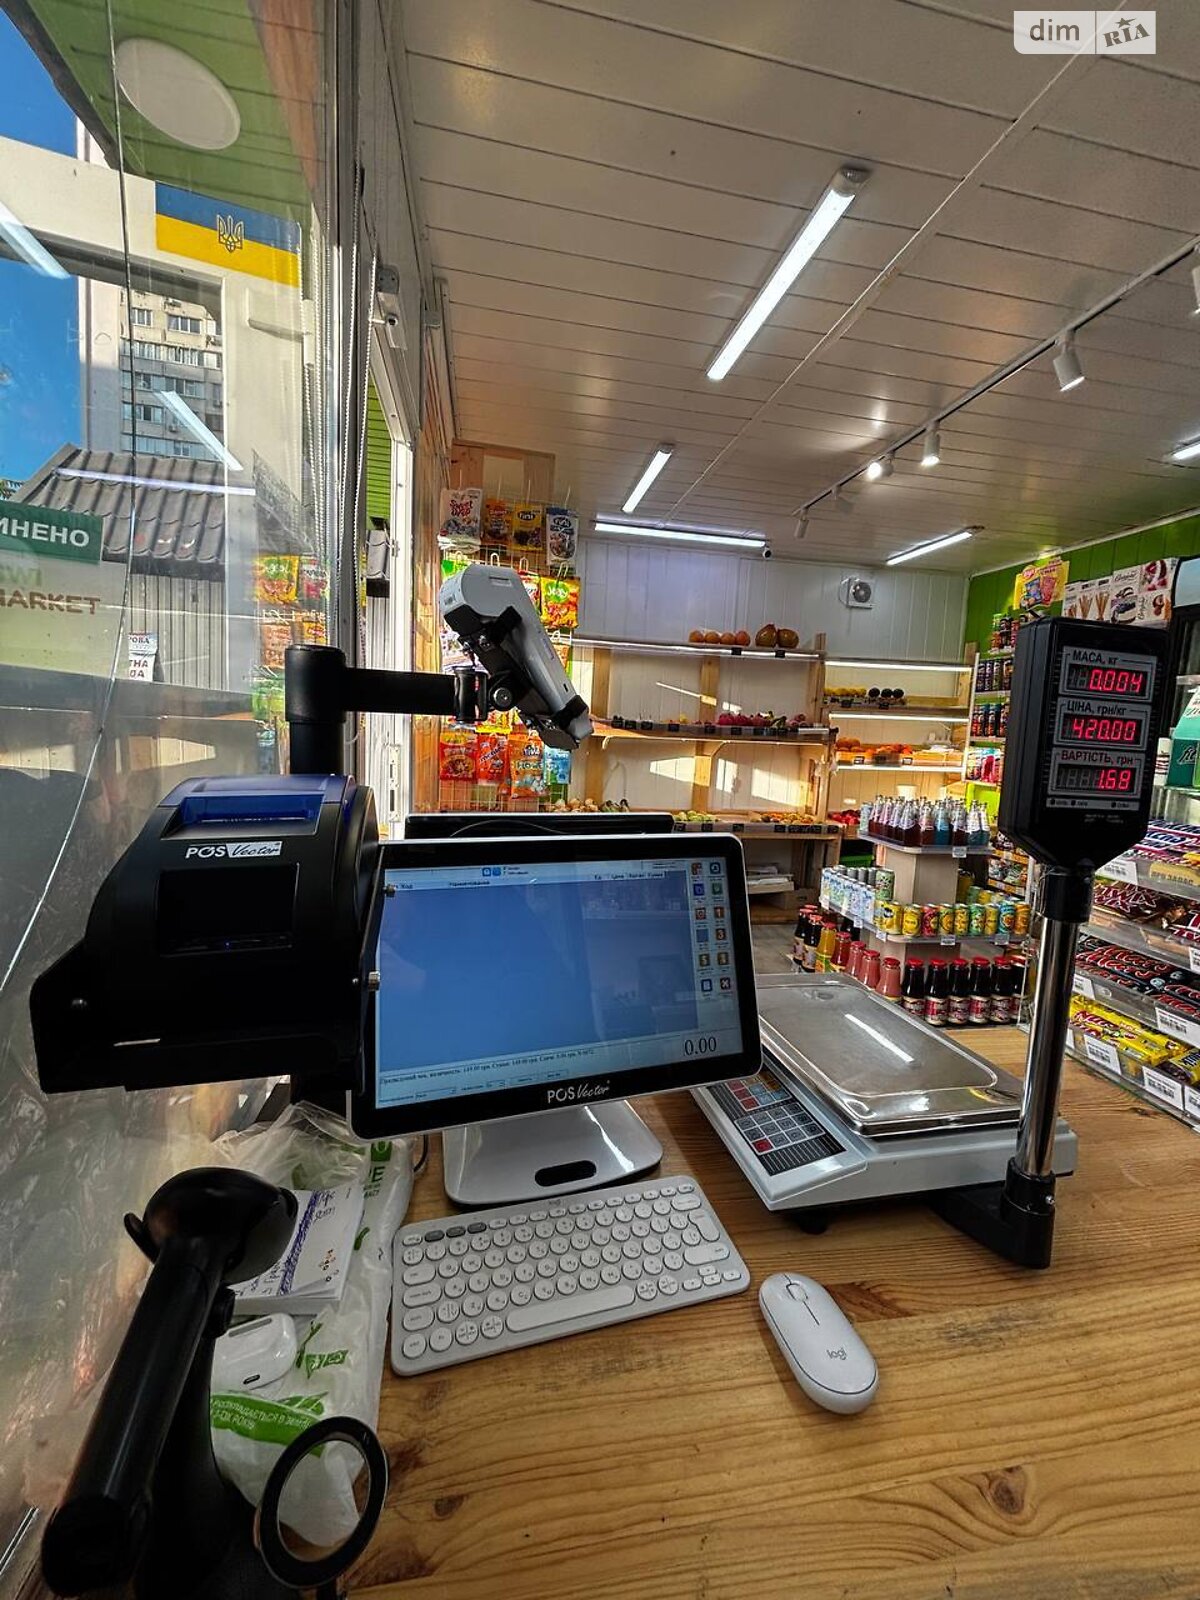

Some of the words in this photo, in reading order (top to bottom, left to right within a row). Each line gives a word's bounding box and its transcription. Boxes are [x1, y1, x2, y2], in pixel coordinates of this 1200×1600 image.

[185, 846, 227, 859] POS
[232, 844, 280, 857] Vector
[684, 1036, 717, 1056] 0.00
[547, 1085, 575, 1103] POS
[576, 1082, 610, 1099] Vector
[826, 1347, 847, 1360] logi
